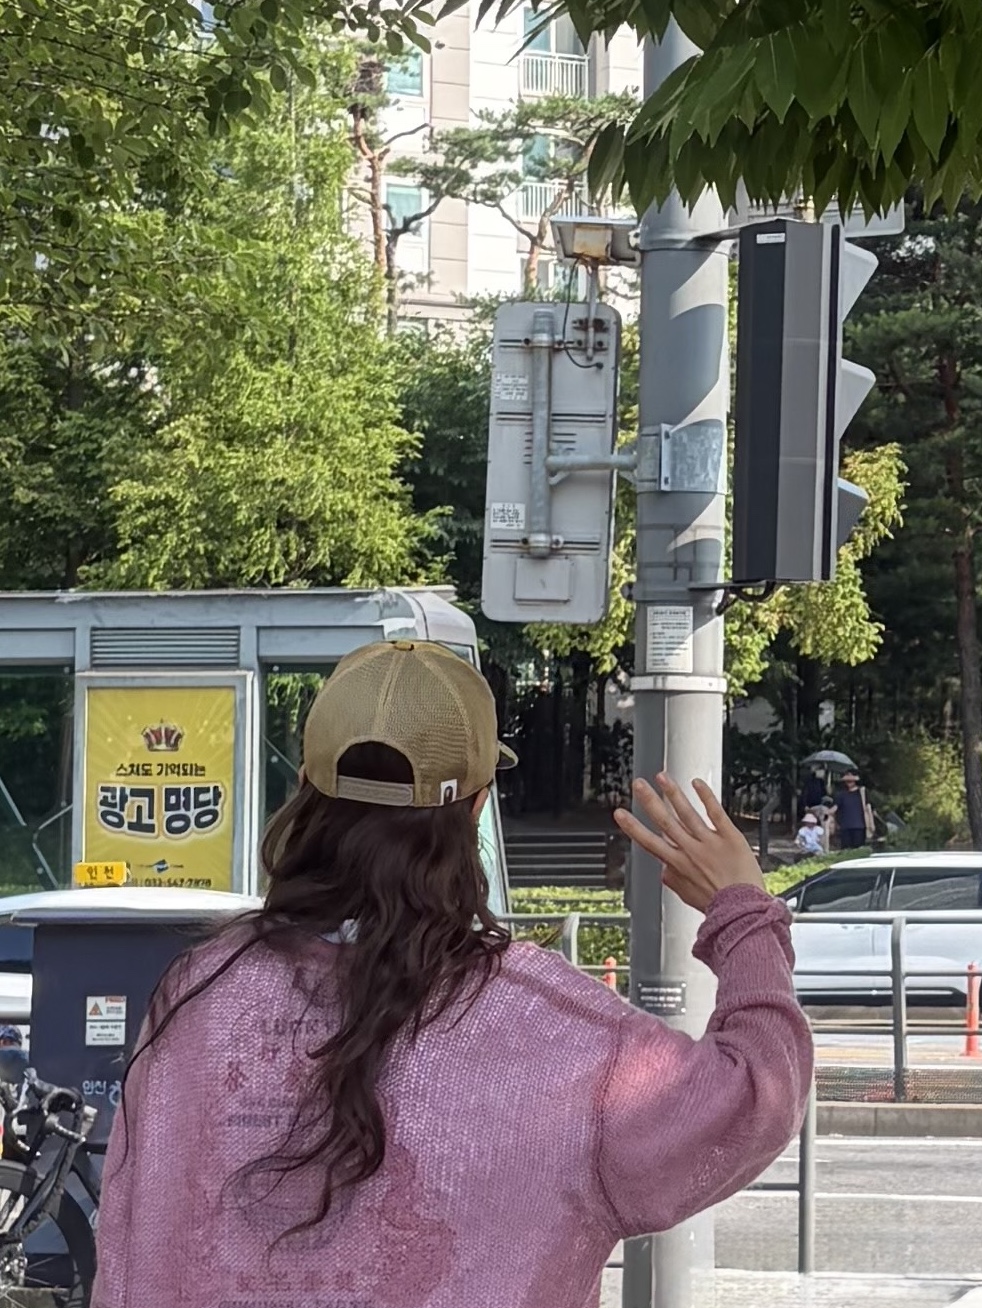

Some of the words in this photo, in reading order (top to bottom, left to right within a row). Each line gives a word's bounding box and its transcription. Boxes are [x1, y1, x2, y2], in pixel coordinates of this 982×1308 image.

[156, 763, 206, 777] 기억되는
[99, 785, 156, 834] 광고
[164, 785, 222, 834] 명당
